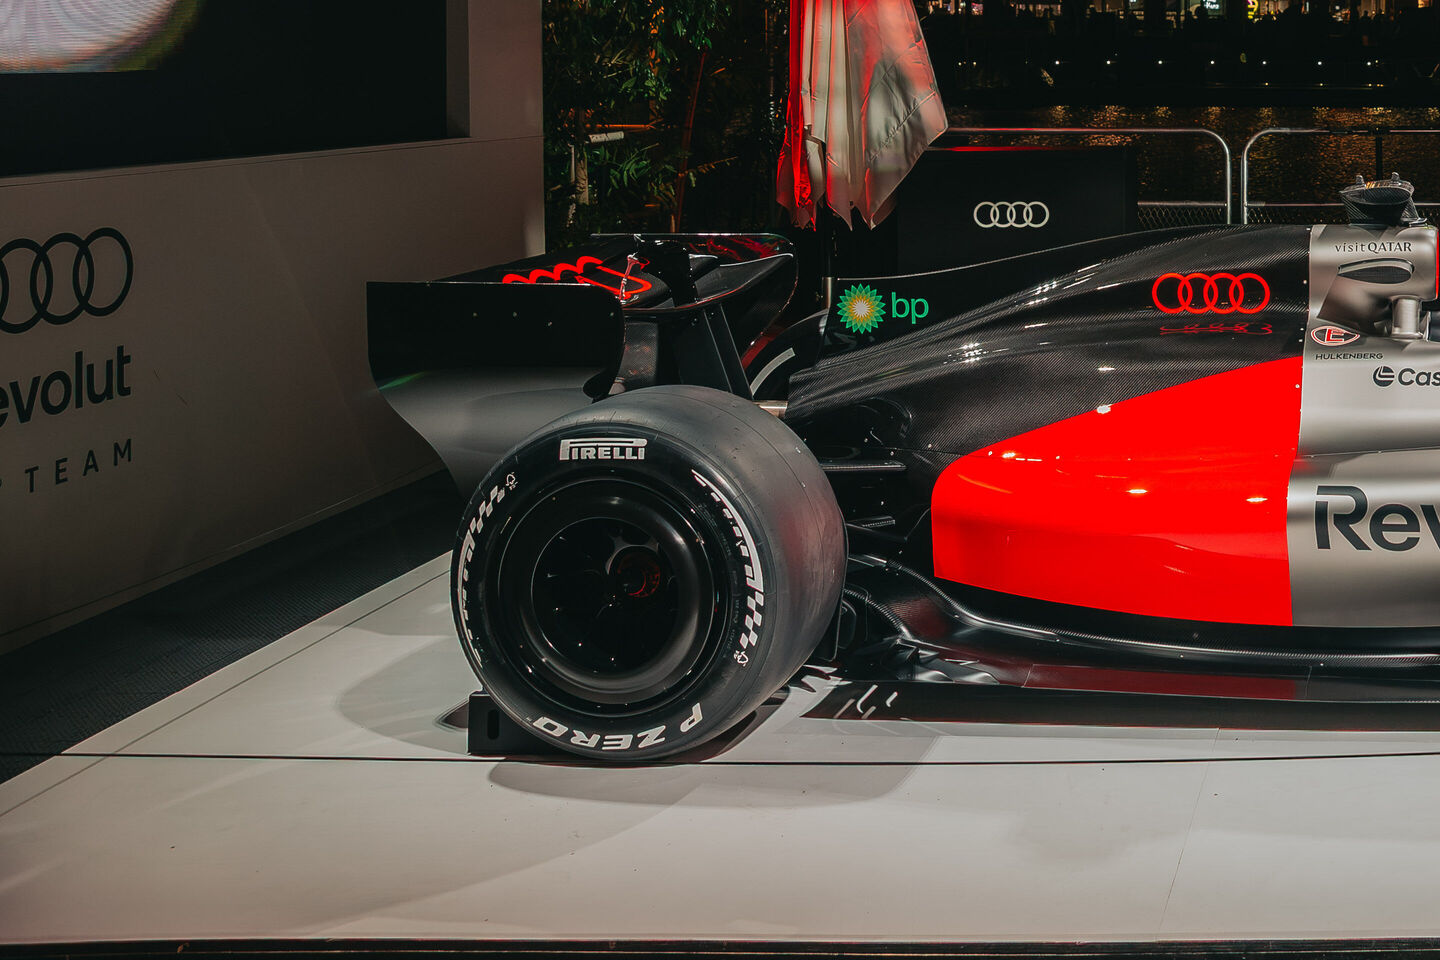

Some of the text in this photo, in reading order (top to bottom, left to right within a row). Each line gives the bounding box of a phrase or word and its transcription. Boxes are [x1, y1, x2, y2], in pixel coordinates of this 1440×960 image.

[891, 291, 930, 325] bp
[25, 438, 132, 493] TEAM
[559, 437, 648, 461] PIRELLI
[532, 702, 705, 751] P ZERO
